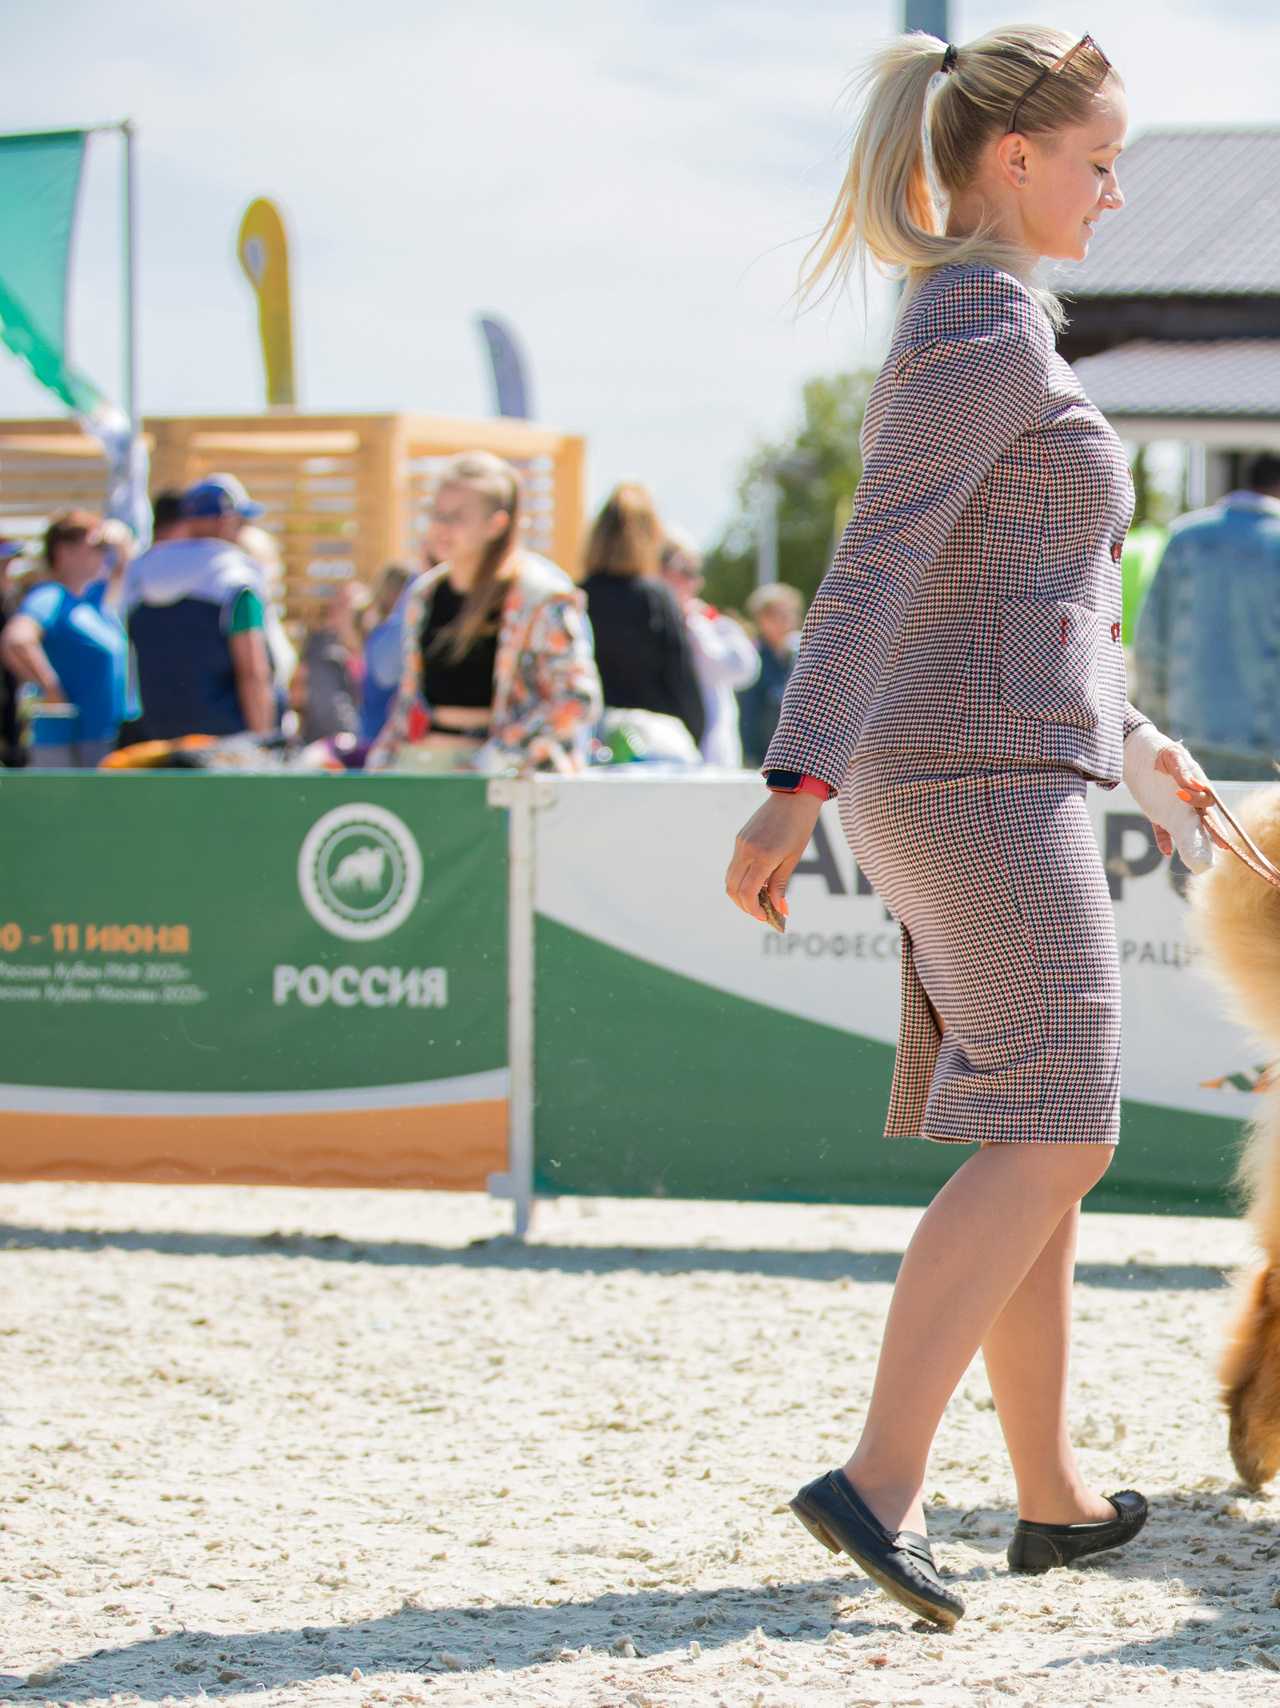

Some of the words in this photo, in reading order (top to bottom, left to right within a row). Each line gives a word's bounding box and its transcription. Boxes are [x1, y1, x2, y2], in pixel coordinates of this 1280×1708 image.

[0, 922, 22, 953] 0
[51, 923, 79, 953] 11
[85, 924, 190, 954] ИЮНЯ
[272, 963, 448, 1008] РОССИЯ
